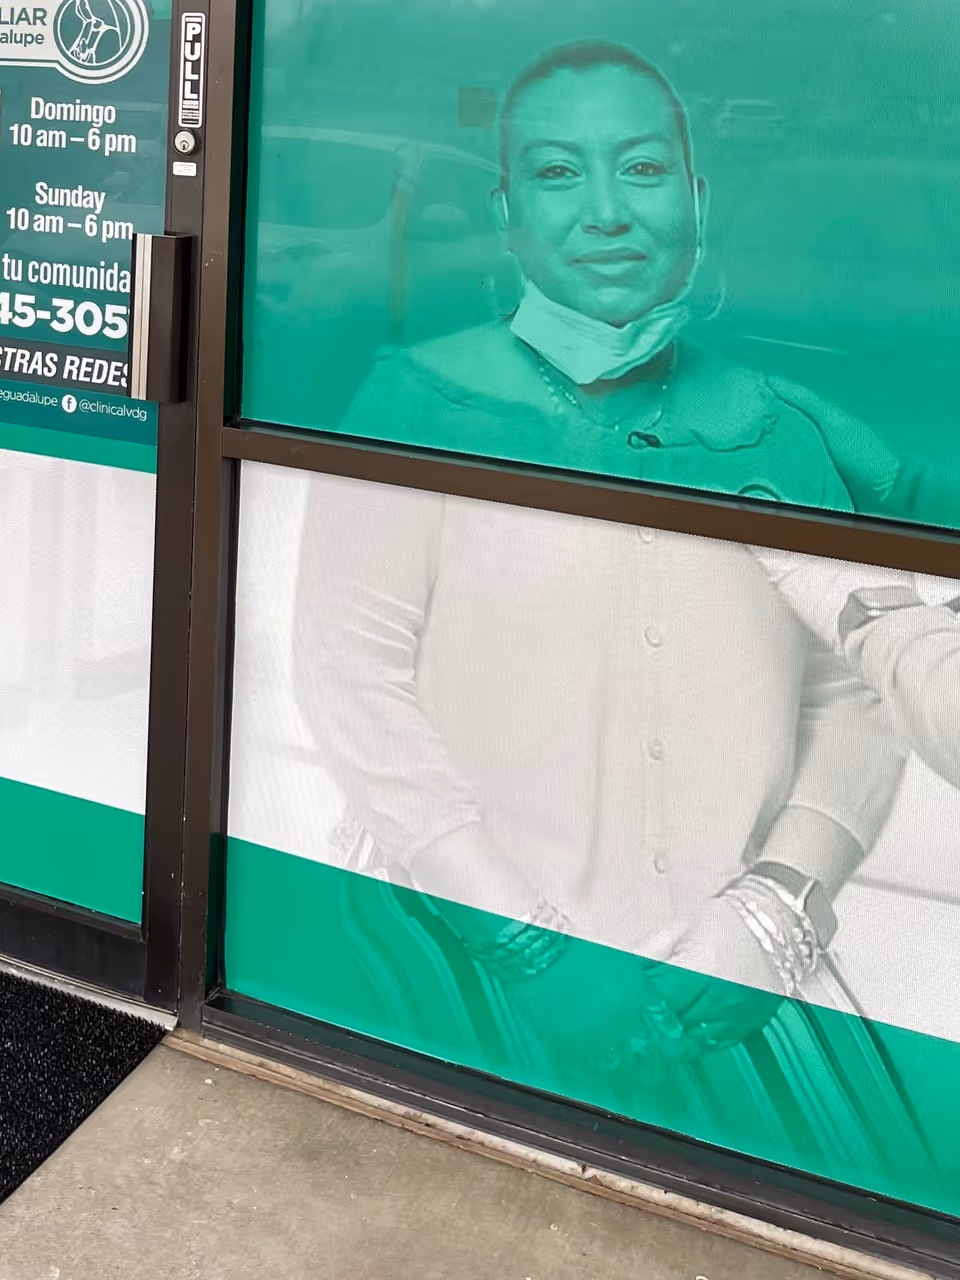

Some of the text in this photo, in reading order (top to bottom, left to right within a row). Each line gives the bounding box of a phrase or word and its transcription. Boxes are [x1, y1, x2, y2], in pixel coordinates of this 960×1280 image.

[183, 22, 202, 100] PULL
[30, 96, 116, 128] Domingo
[9, 123, 33, 146] 10
[36, 129, 67, 149] am
[87, 127, 100, 151] 6
[104, 132, 137, 156] pm
[34, 181, 106, 214] Sunday
[6, 207, 30, 231] 10
[33, 213, 64, 234] am
[85, 214, 98, 237] 6
[101, 220, 134, 243] pm
[2, 253, 23, 282] tu
[79, 398, 148, 422] @clinicalvdg
